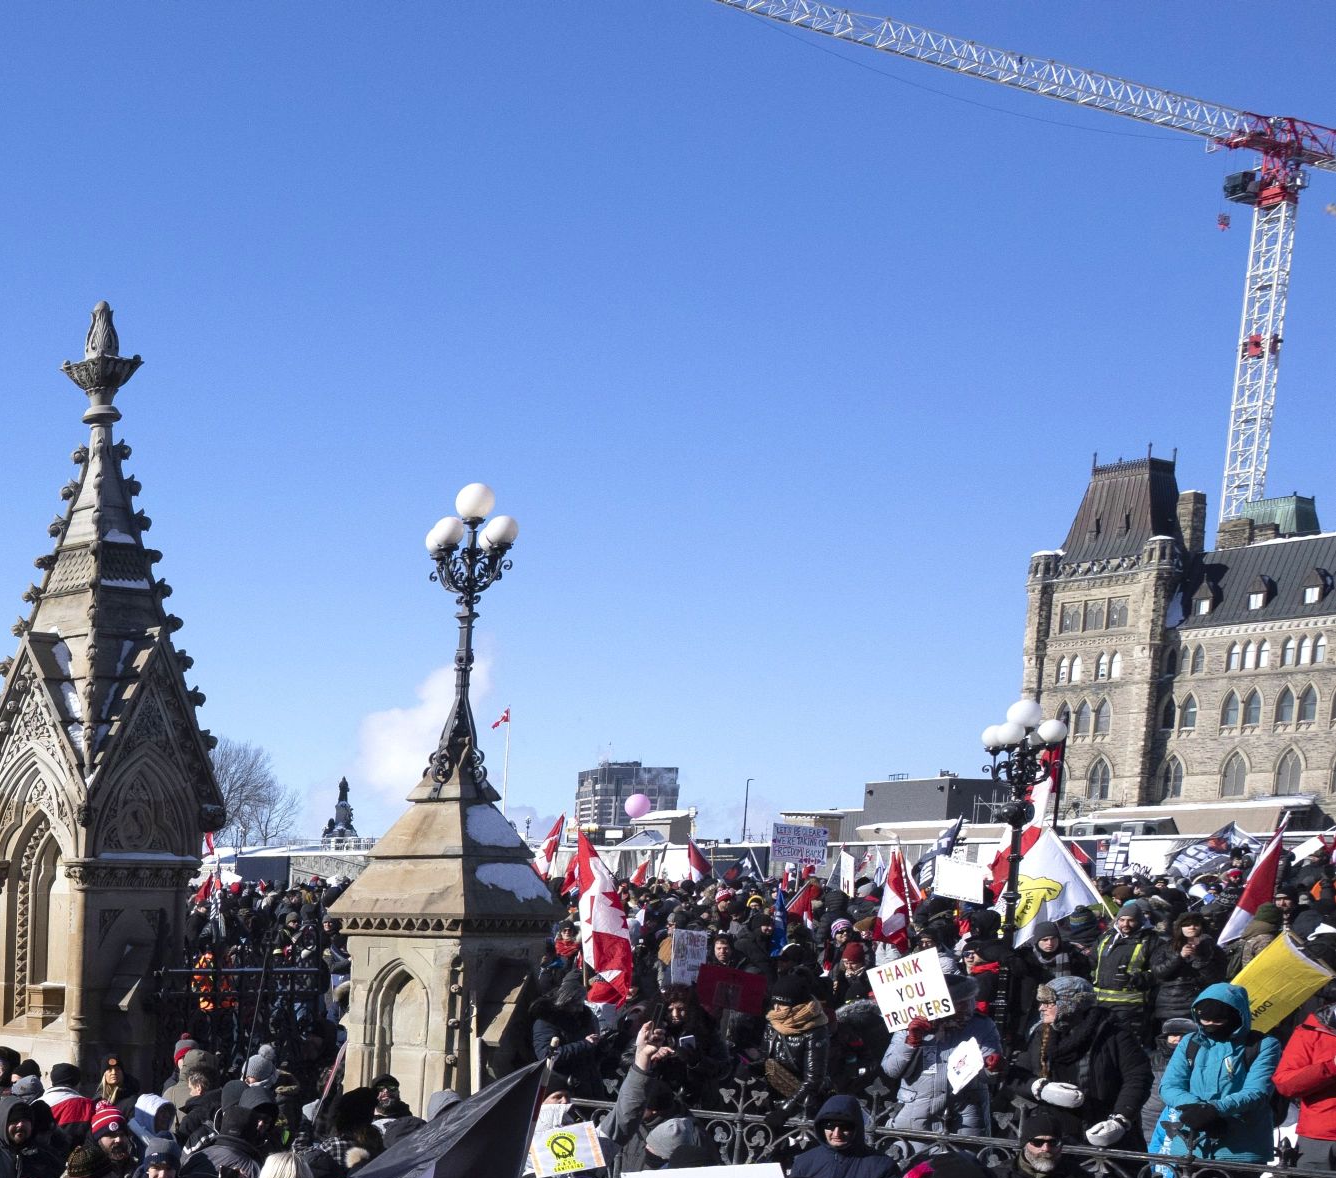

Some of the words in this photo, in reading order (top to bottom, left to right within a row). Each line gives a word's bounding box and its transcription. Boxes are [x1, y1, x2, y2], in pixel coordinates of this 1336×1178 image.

[876, 957, 923, 985] THANK
[895, 981, 926, 1003] YOU
[884, 998, 951, 1028] TRUCKERS
